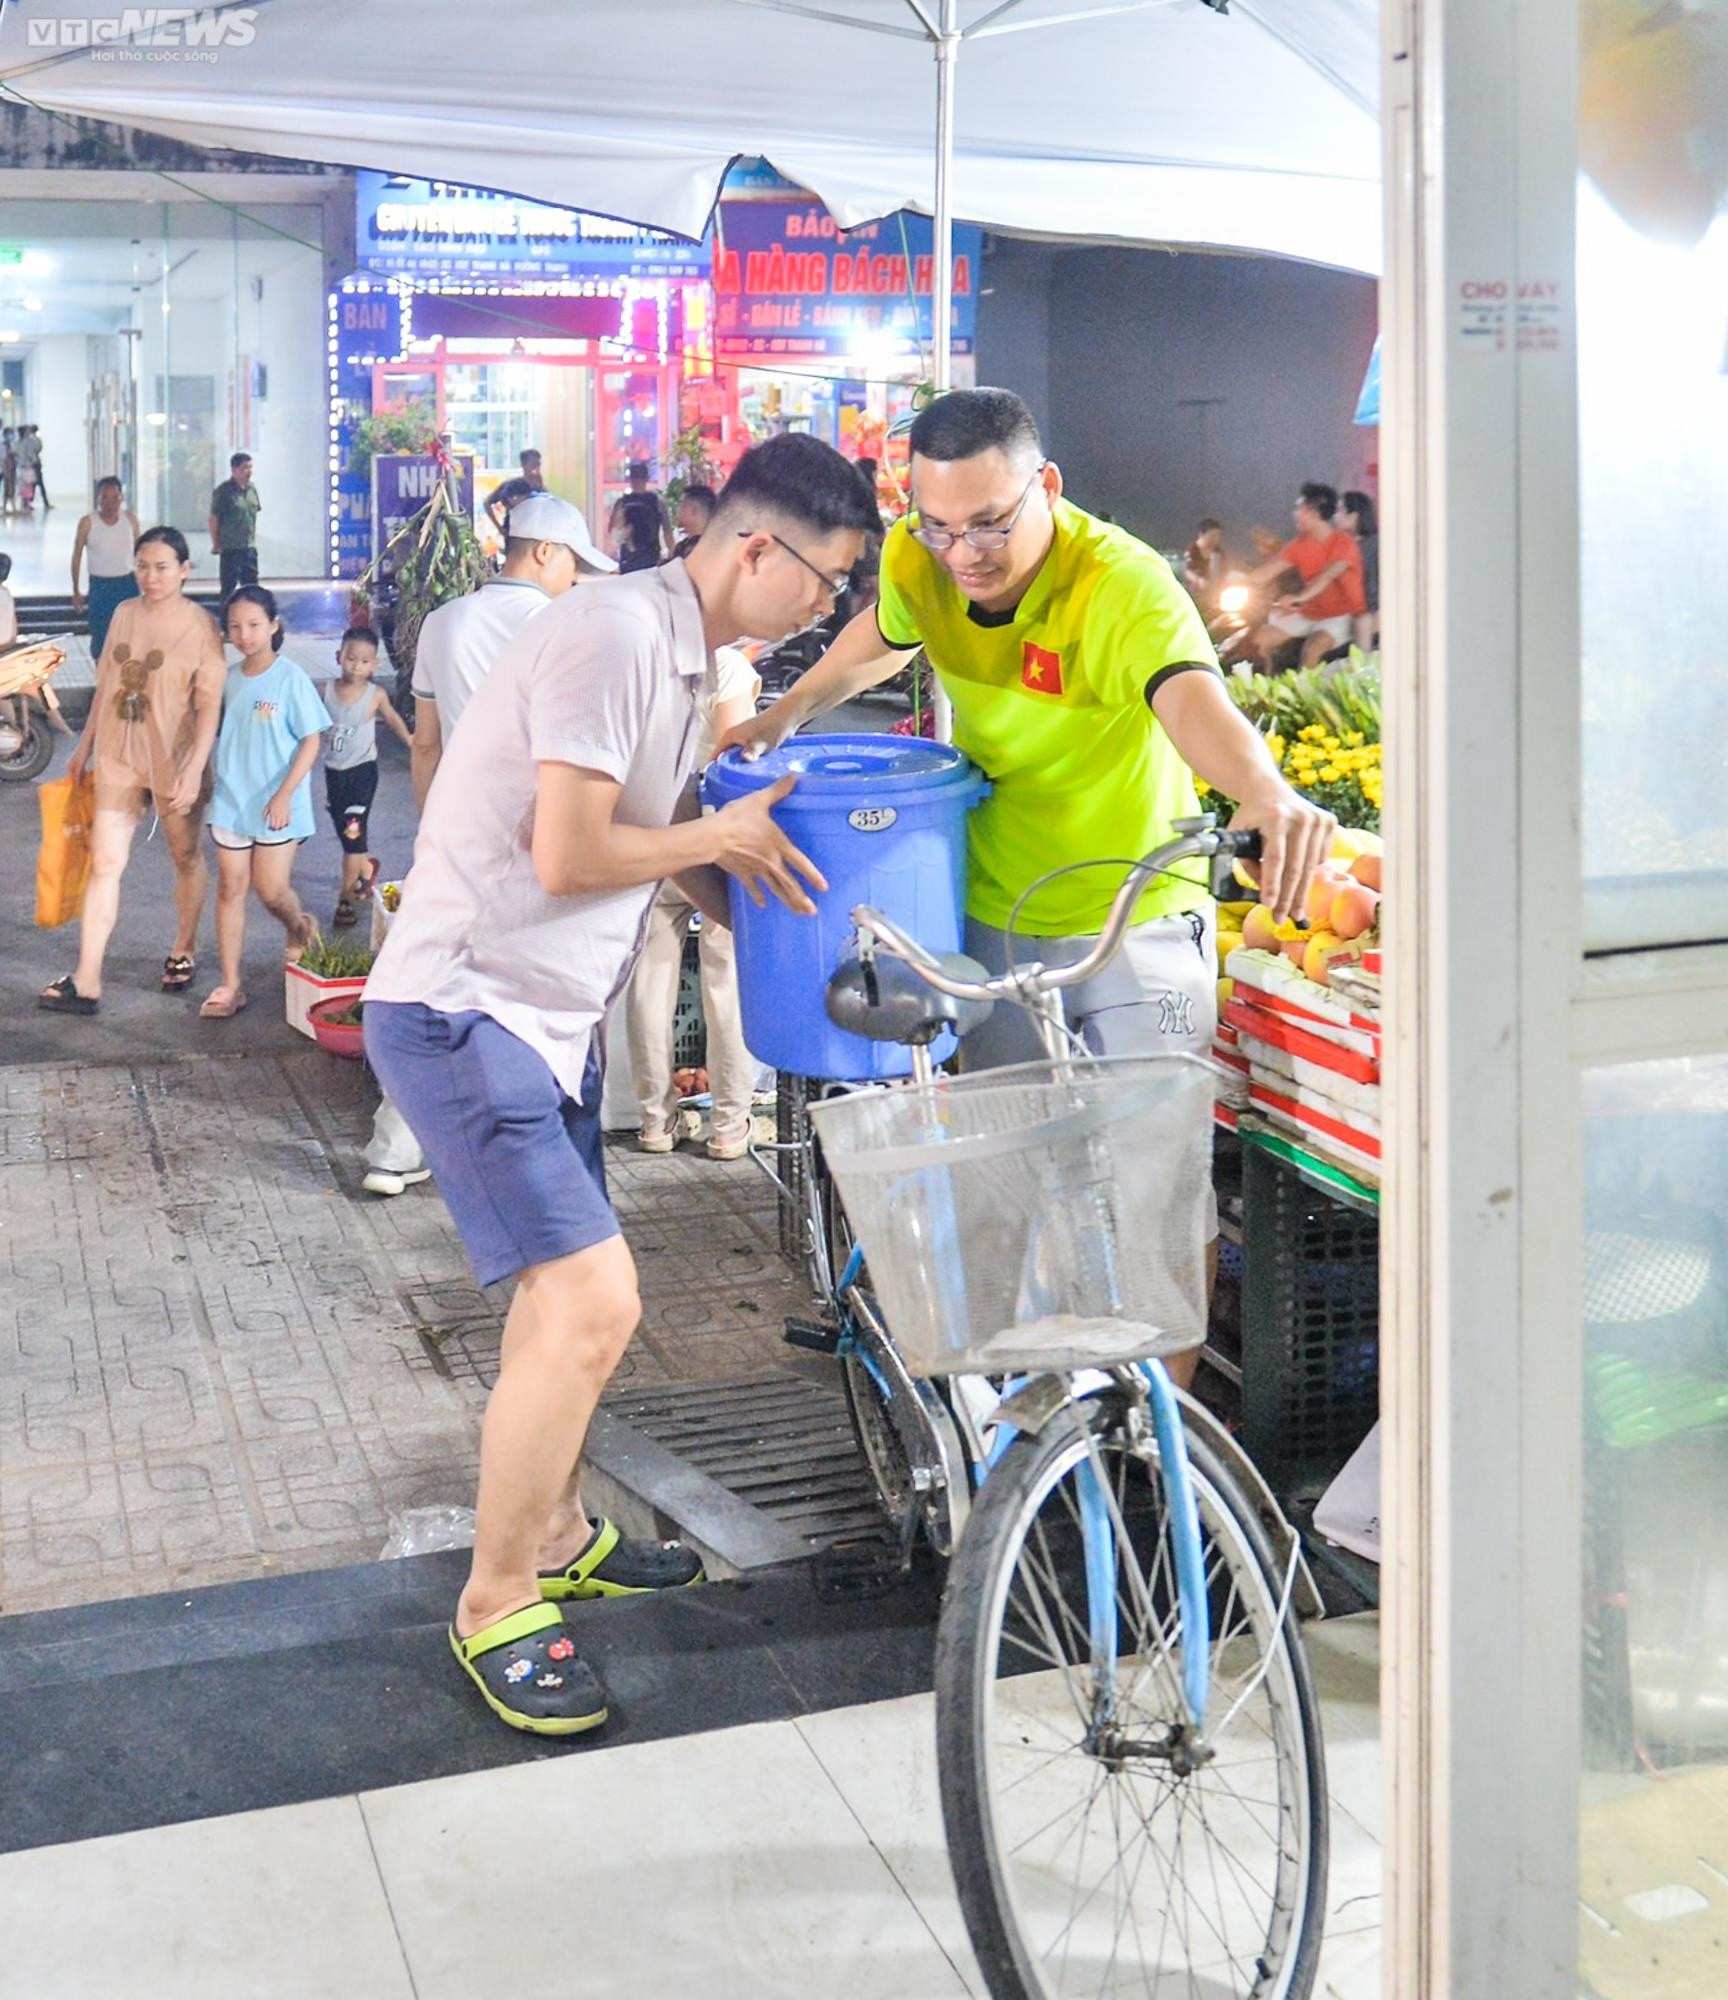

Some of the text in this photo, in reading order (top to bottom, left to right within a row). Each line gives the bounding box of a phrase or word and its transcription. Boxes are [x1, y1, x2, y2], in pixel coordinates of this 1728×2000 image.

[745, 245, 827, 296] HÀNG
[832, 247, 909, 296] BÁCH
[914, 254, 971, 296] HA
[1460, 281, 1560, 300] CHO VAY
[344, 296, 387, 331] BÁN
[398, 465, 438, 498] NH
